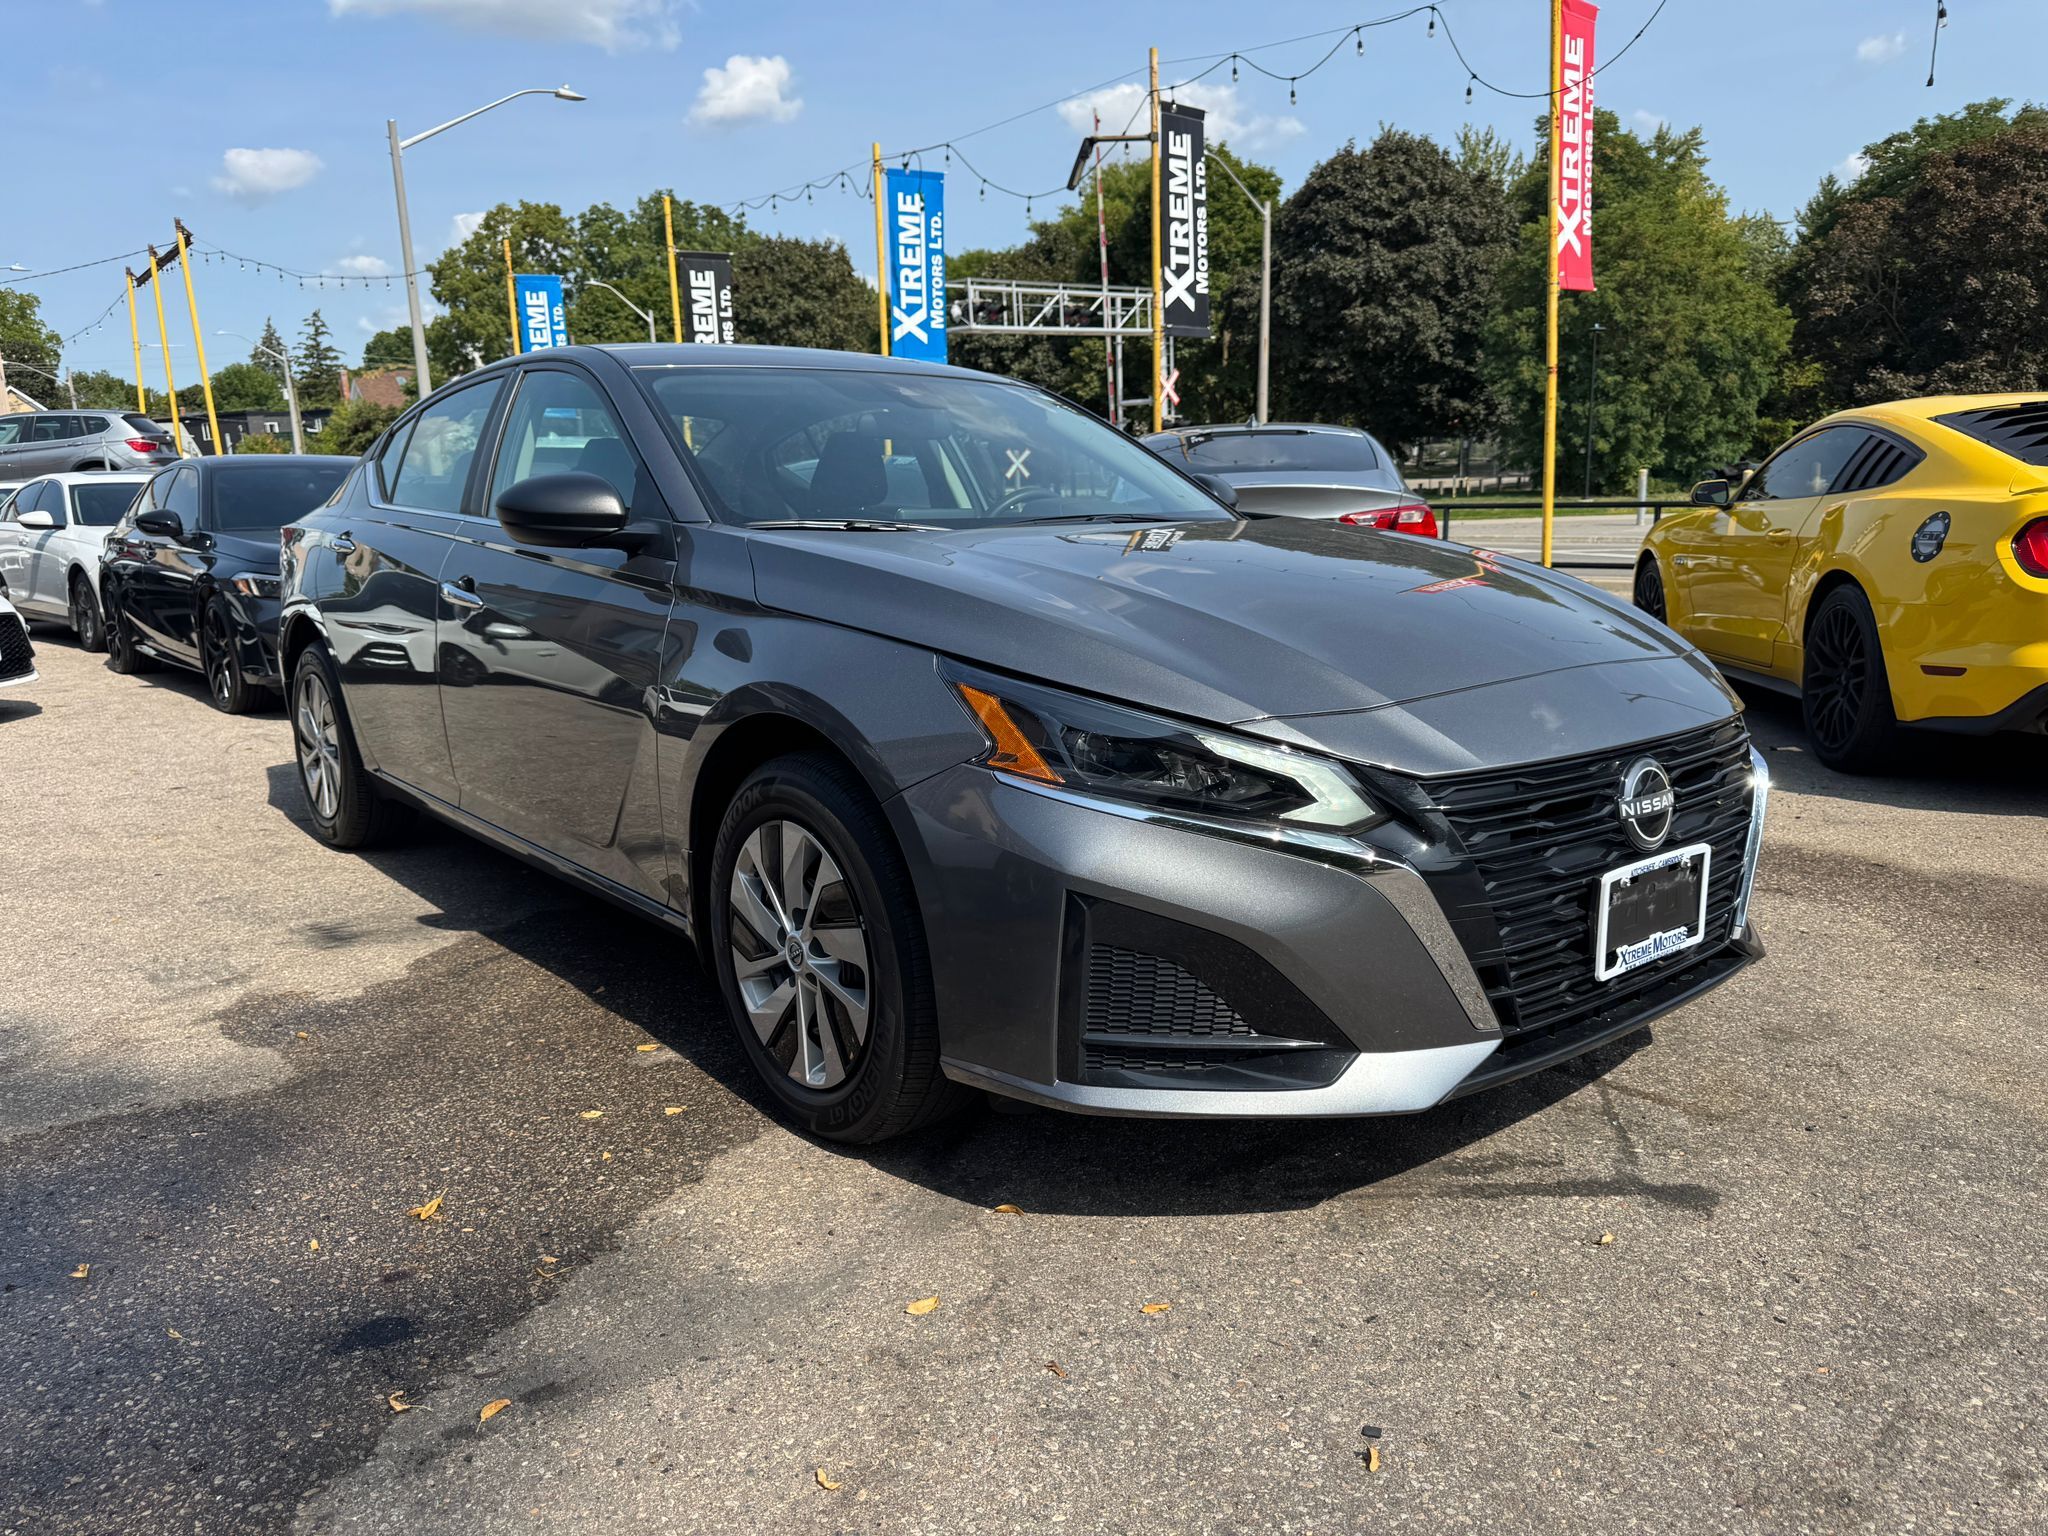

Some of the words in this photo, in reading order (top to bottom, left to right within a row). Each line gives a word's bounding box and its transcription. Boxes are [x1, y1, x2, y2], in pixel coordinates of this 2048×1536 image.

[1194, 156, 1206, 201] LTD.
[1558, 34, 1585, 258] XTREME
[1582, 129, 1593, 236] MOTORS
[929, 211, 943, 250] LTD.
[1164, 130, 1196, 313] XTREME
[1195, 206, 1210, 295] MOTORS
[719, 285, 733, 318] LTD.
[892, 191, 929, 345] XTREME
[930, 254, 945, 330] MOTORS
[552, 302, 566, 331] LTD.
[689, 269, 720, 345] REME
[1621, 790, 1675, 818] NISSAN
[1620, 942, 1652, 968] XTREME
[1652, 930, 1688, 954] MOTORS
